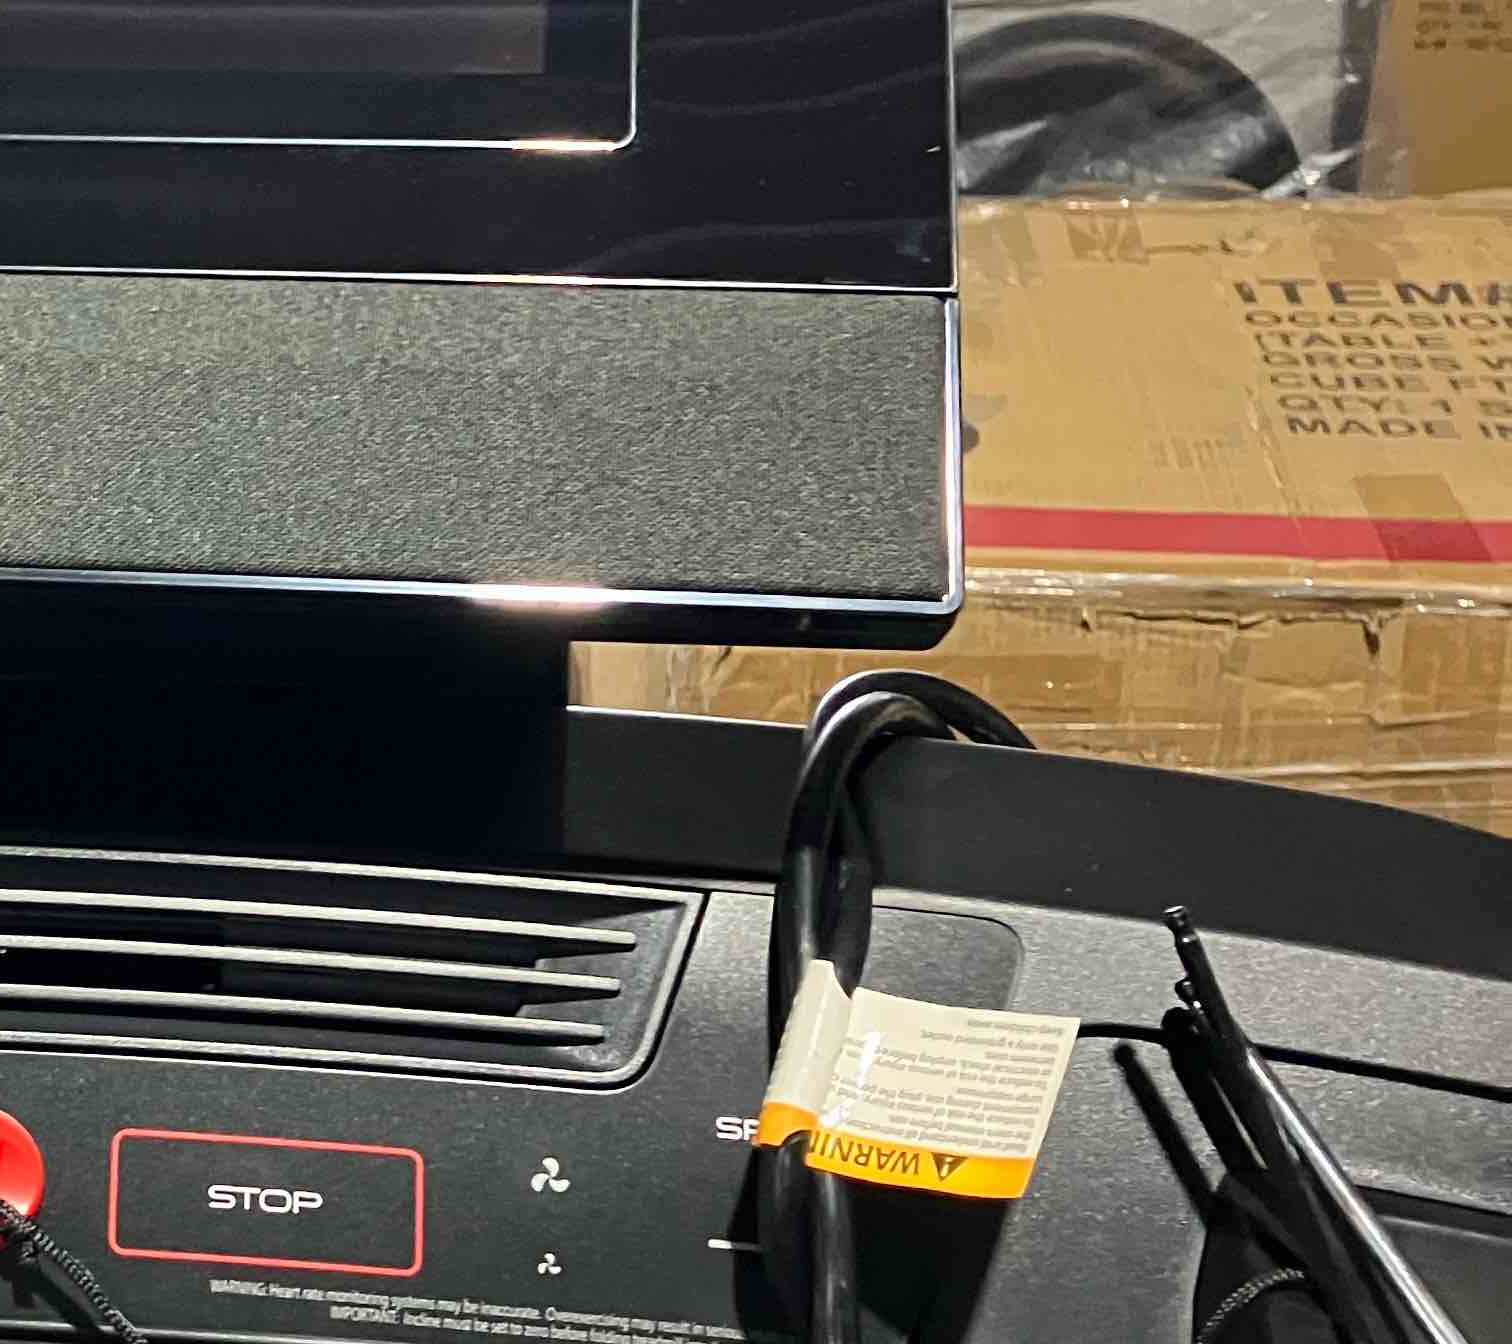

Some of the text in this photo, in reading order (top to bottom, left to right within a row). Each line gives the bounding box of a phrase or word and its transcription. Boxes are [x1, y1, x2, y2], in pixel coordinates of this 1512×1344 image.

[1263, 351, 1464, 371] GROSS
[1269, 372, 1431, 394] CUBE
[1287, 417, 1462, 440] MADE
[810, 1129, 921, 1176] WARNI
[208, 1184, 324, 1215] STOP
